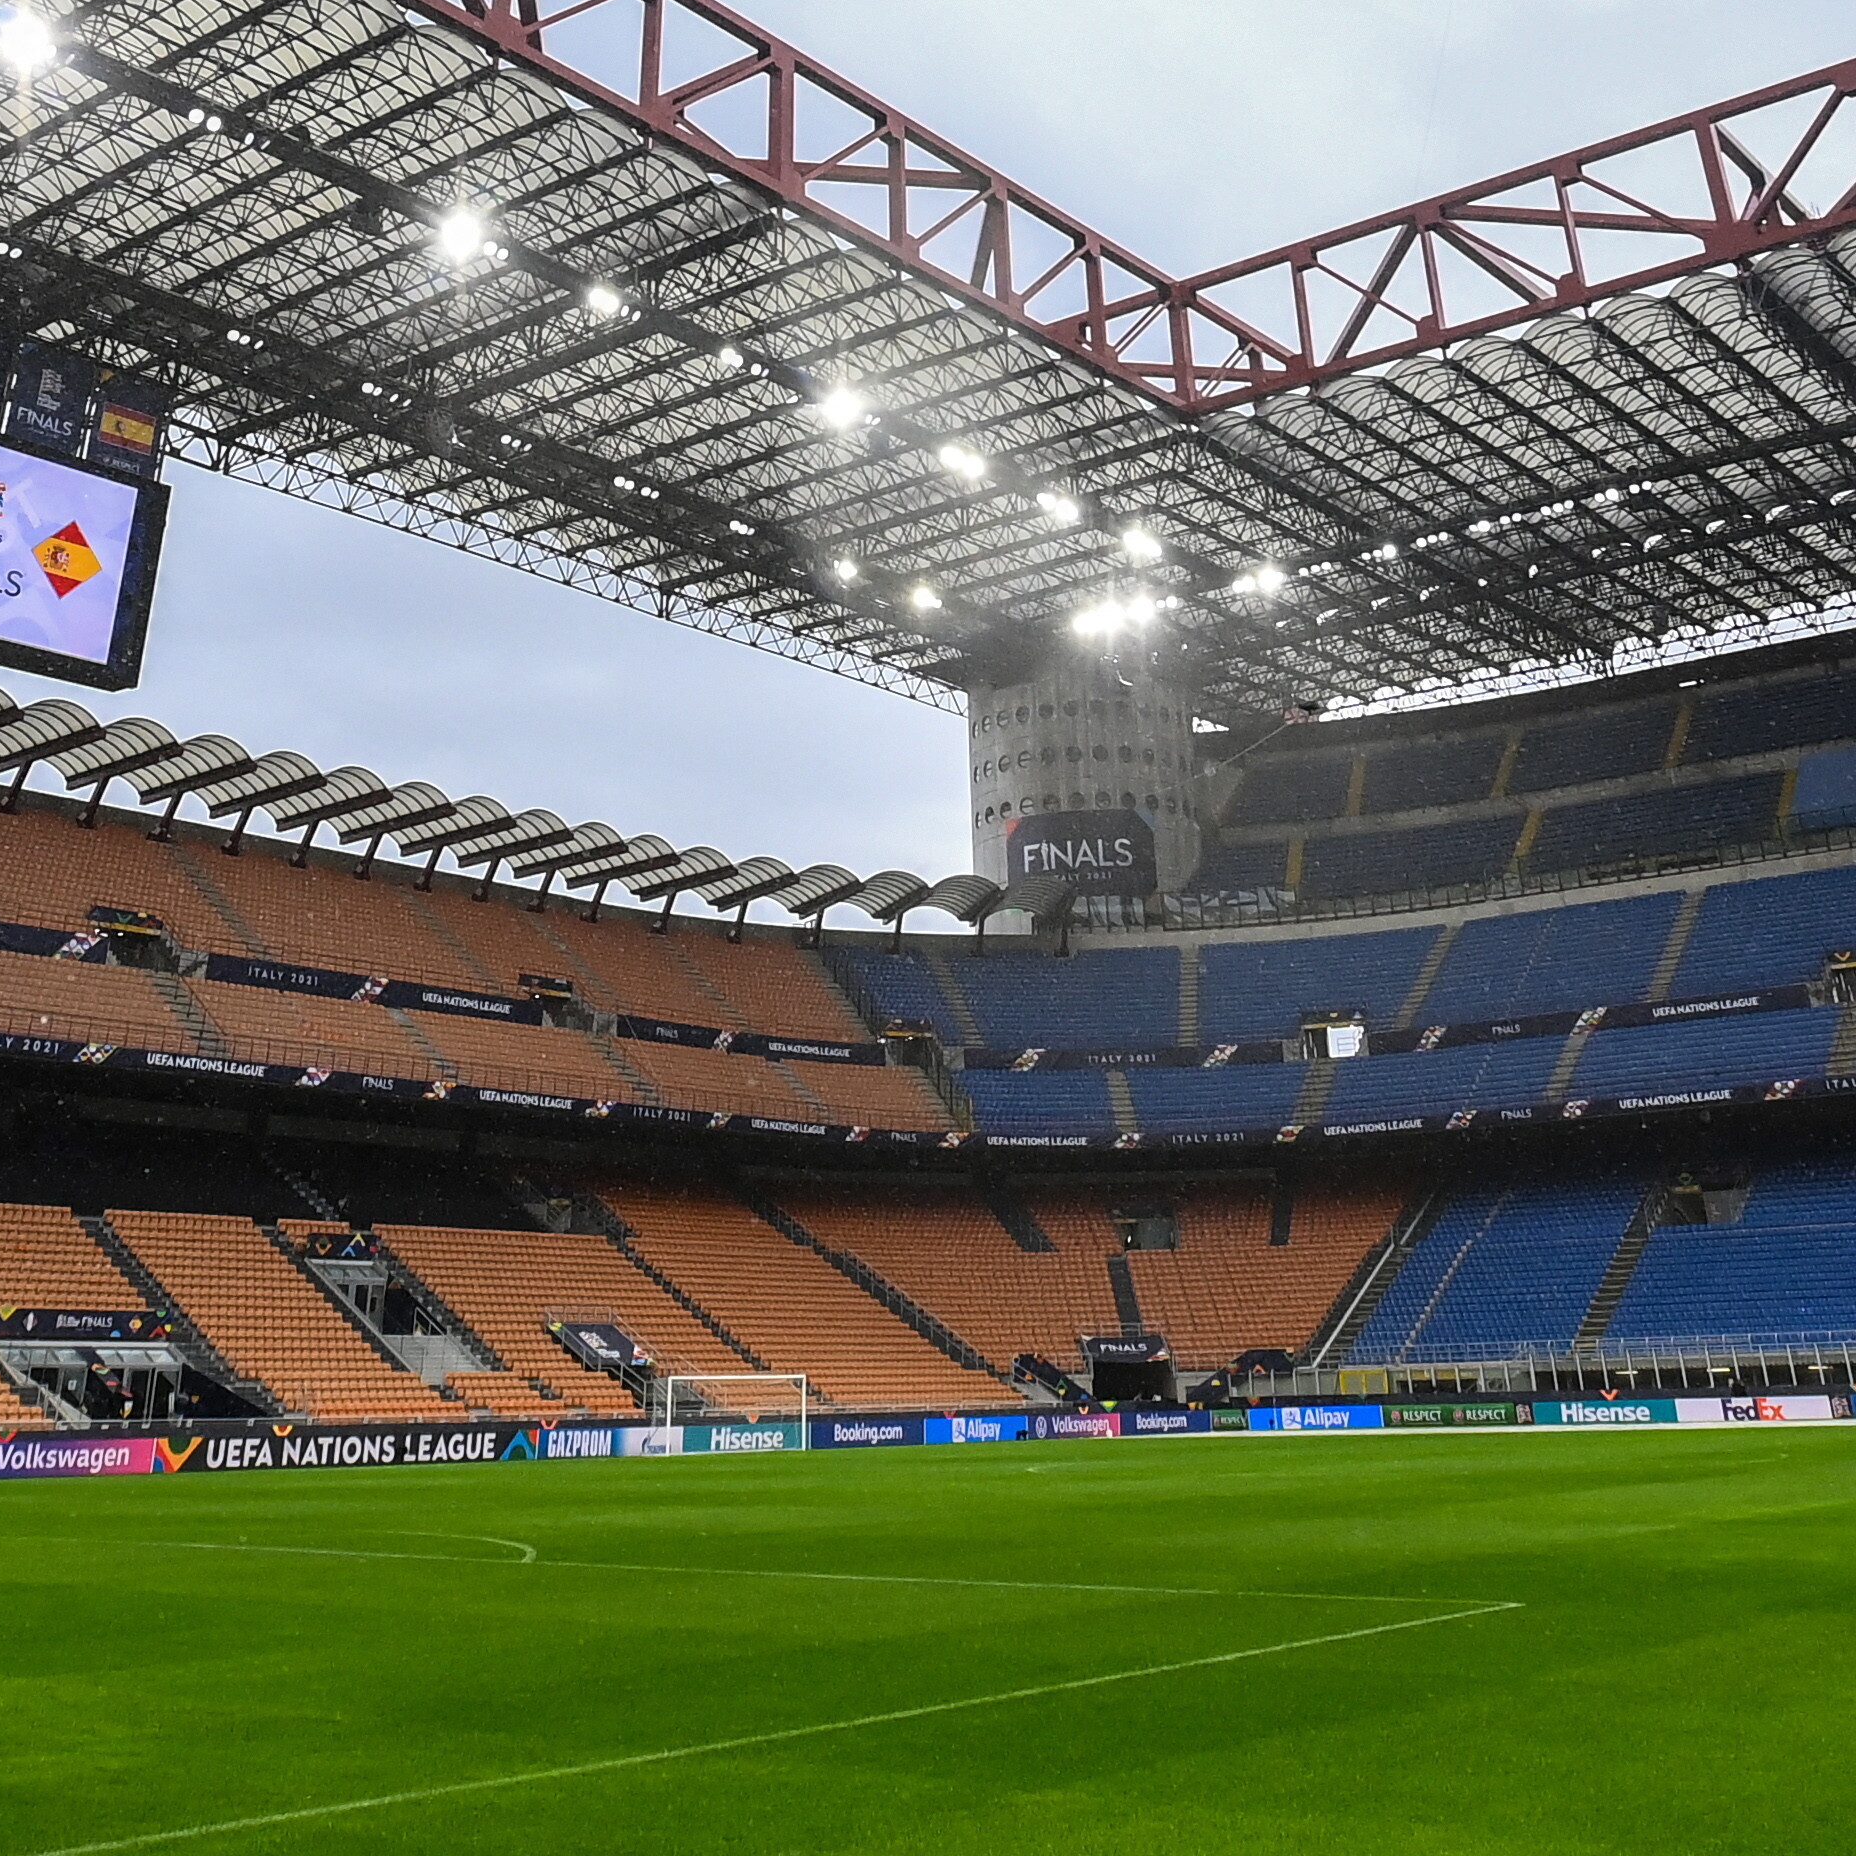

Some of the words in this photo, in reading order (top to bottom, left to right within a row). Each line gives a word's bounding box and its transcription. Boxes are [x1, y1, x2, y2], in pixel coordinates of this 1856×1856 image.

[17, 406, 73, 435] FINALS
[1024, 838, 1133, 873] FINALS
[247, 966, 284, 981] ITALY
[290, 973, 318, 987] 2021
[422, 992, 443, 1004] UEFA
[443, 994, 479, 1010] NATIONS
[479, 1000, 511, 1014] LEAGUE
[1652, 1006, 1676, 1017] UEFA
[1677, 1001, 1719, 1015] NATIONS
[1720, 996, 1759, 1009] LEAGUE
[1492, 1024, 1520, 1035] FINALS
[23, 1038, 59, 1054] 2021
[768, 1043, 787, 1052] UEFA
[787, 1044, 819, 1056] NATIONS
[820, 1047, 851, 1058] LEAGUE
[147, 1052, 175, 1067] UEFA
[175, 1055, 224, 1073] NATIONS
[223, 1063, 265, 1077] LEAGUE
[1088, 1055, 1122, 1063] ITALY
[1129, 1054, 1156, 1062] 2021
[362, 1075, 393, 1090] FINALS
[479, 1089, 501, 1102] UEFA
[501, 1092, 539, 1107] NATIONS
[539, 1096, 572, 1110] LEAGUE
[1619, 1097, 1645, 1109] UEFA
[1645, 1093, 1689, 1107] NATIONS
[1690, 1089, 1732, 1102] LEAGUE
[632, 1107, 663, 1118] ITALY
[667, 1110, 691, 1122] 2021
[1501, 1108, 1532, 1120] FINALS
[751, 1118, 770, 1129] UEFA
[770, 1120, 799, 1132] NATIONS
[800, 1124, 826, 1135] LEAGUE
[1323, 1126, 1346, 1136] UEFA
[1346, 1122, 1386, 1135] NATIONS
[1387, 1119, 1423, 1130] LEAGUE
[987, 1136, 1010, 1146] UEFA
[1010, 1137, 1050, 1146] NATIONS
[1051, 1137, 1088, 1146] LEAGUE
[1172, 1134, 1208, 1144] ITALY
[1216, 1132, 1245, 1142] 2021
[1099, 1343, 1147, 1353] FINALS
[1304, 1408, 1350, 1429] Alipay
[1404, 1410, 1442, 1421] RESPECT
[1466, 1409, 1506, 1420] RESPECT
[1560, 1402, 1651, 1423] Hisense
[1720, 1397, 1786, 1421] FedEx
[967, 1419, 1001, 1442] Alipay
[1052, 1416, 1110, 1436] Volkswagen
[1136, 1413, 1187, 1432] Booking.com
[710, 1427, 784, 1451] Hisense
[834, 1422, 903, 1444] Booking.com
[206, 1437, 273, 1469] UEFA
[281, 1434, 396, 1467] NATIONS
[403, 1432, 497, 1462] LEAGUE
[547, 1430, 612, 1458] GAZPROM
